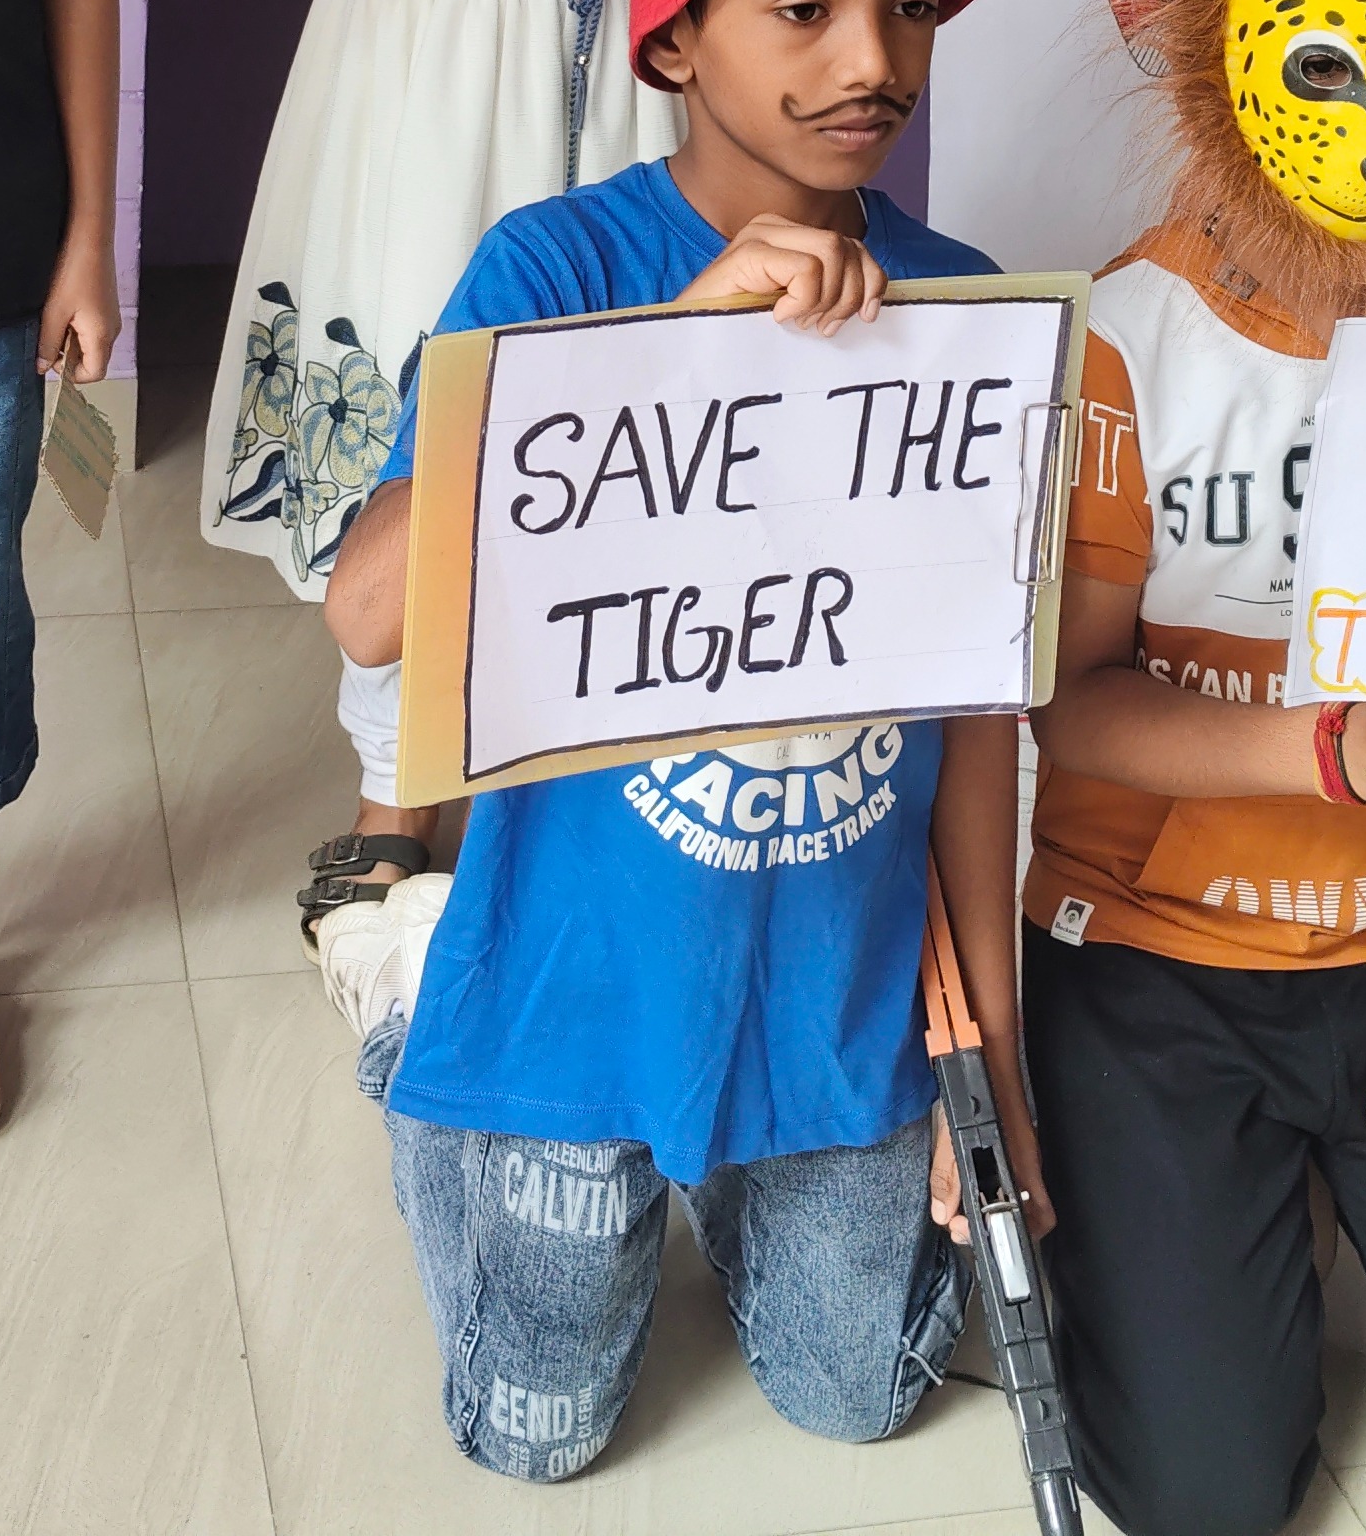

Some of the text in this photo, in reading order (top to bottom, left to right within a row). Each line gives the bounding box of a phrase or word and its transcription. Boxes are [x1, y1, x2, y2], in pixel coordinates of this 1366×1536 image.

[509, 391, 785, 535] SAVE
[827, 377, 1013, 500] THE
[546, 566, 855, 698] TIGER
[623, 774, 759, 872] CALIFORNIA
[505, 1151, 627, 1237] CALVIN
